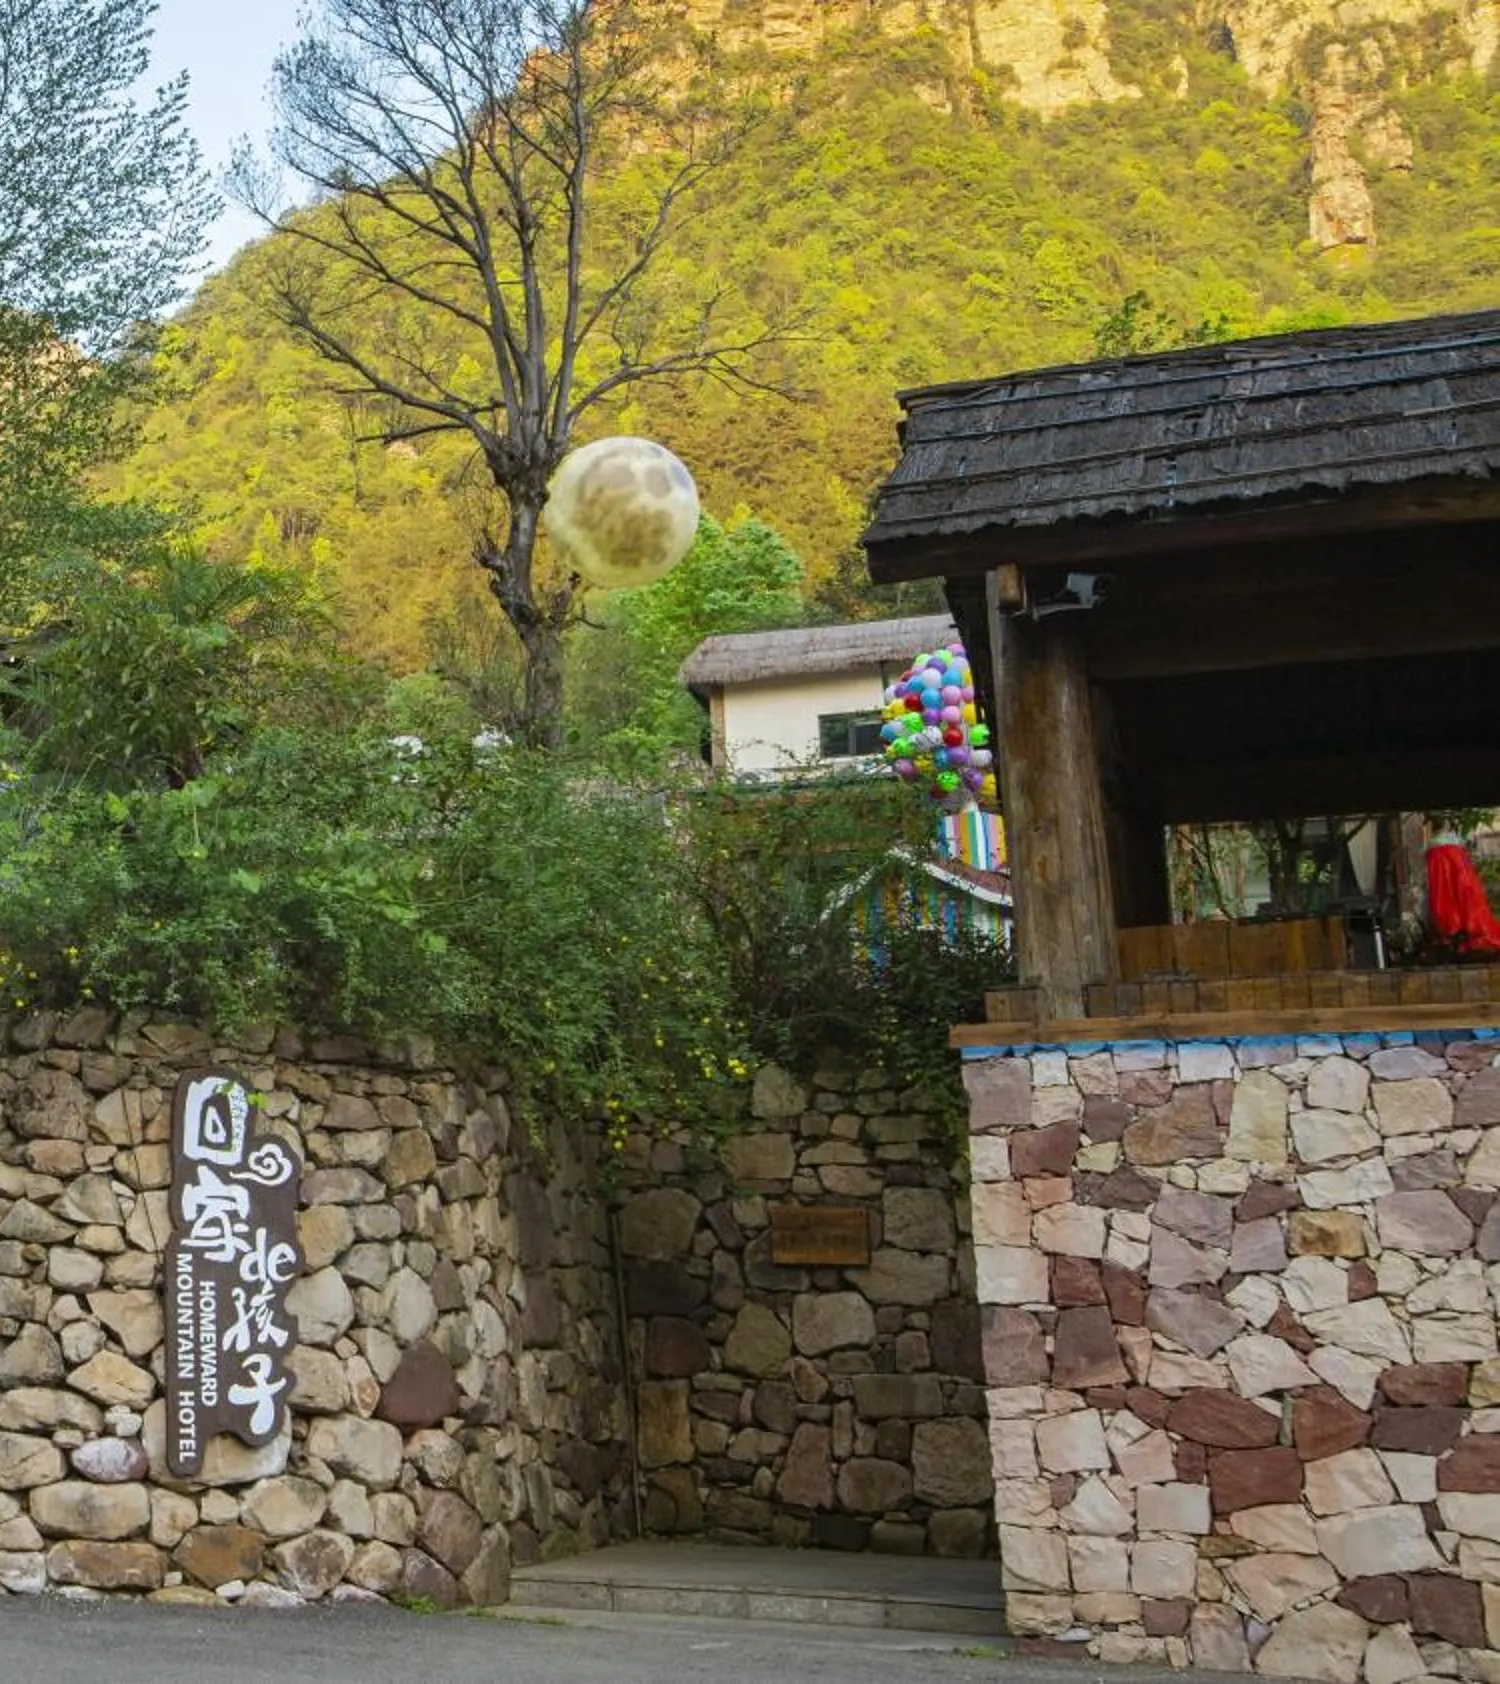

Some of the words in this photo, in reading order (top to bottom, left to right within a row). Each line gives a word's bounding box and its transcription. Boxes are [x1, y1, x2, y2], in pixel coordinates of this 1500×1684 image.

[175, 1252, 194, 1378] MOUNTAIN
[199, 1280, 217, 1408] HOMEWARD
[177, 1393, 197, 1464] HOTEL
